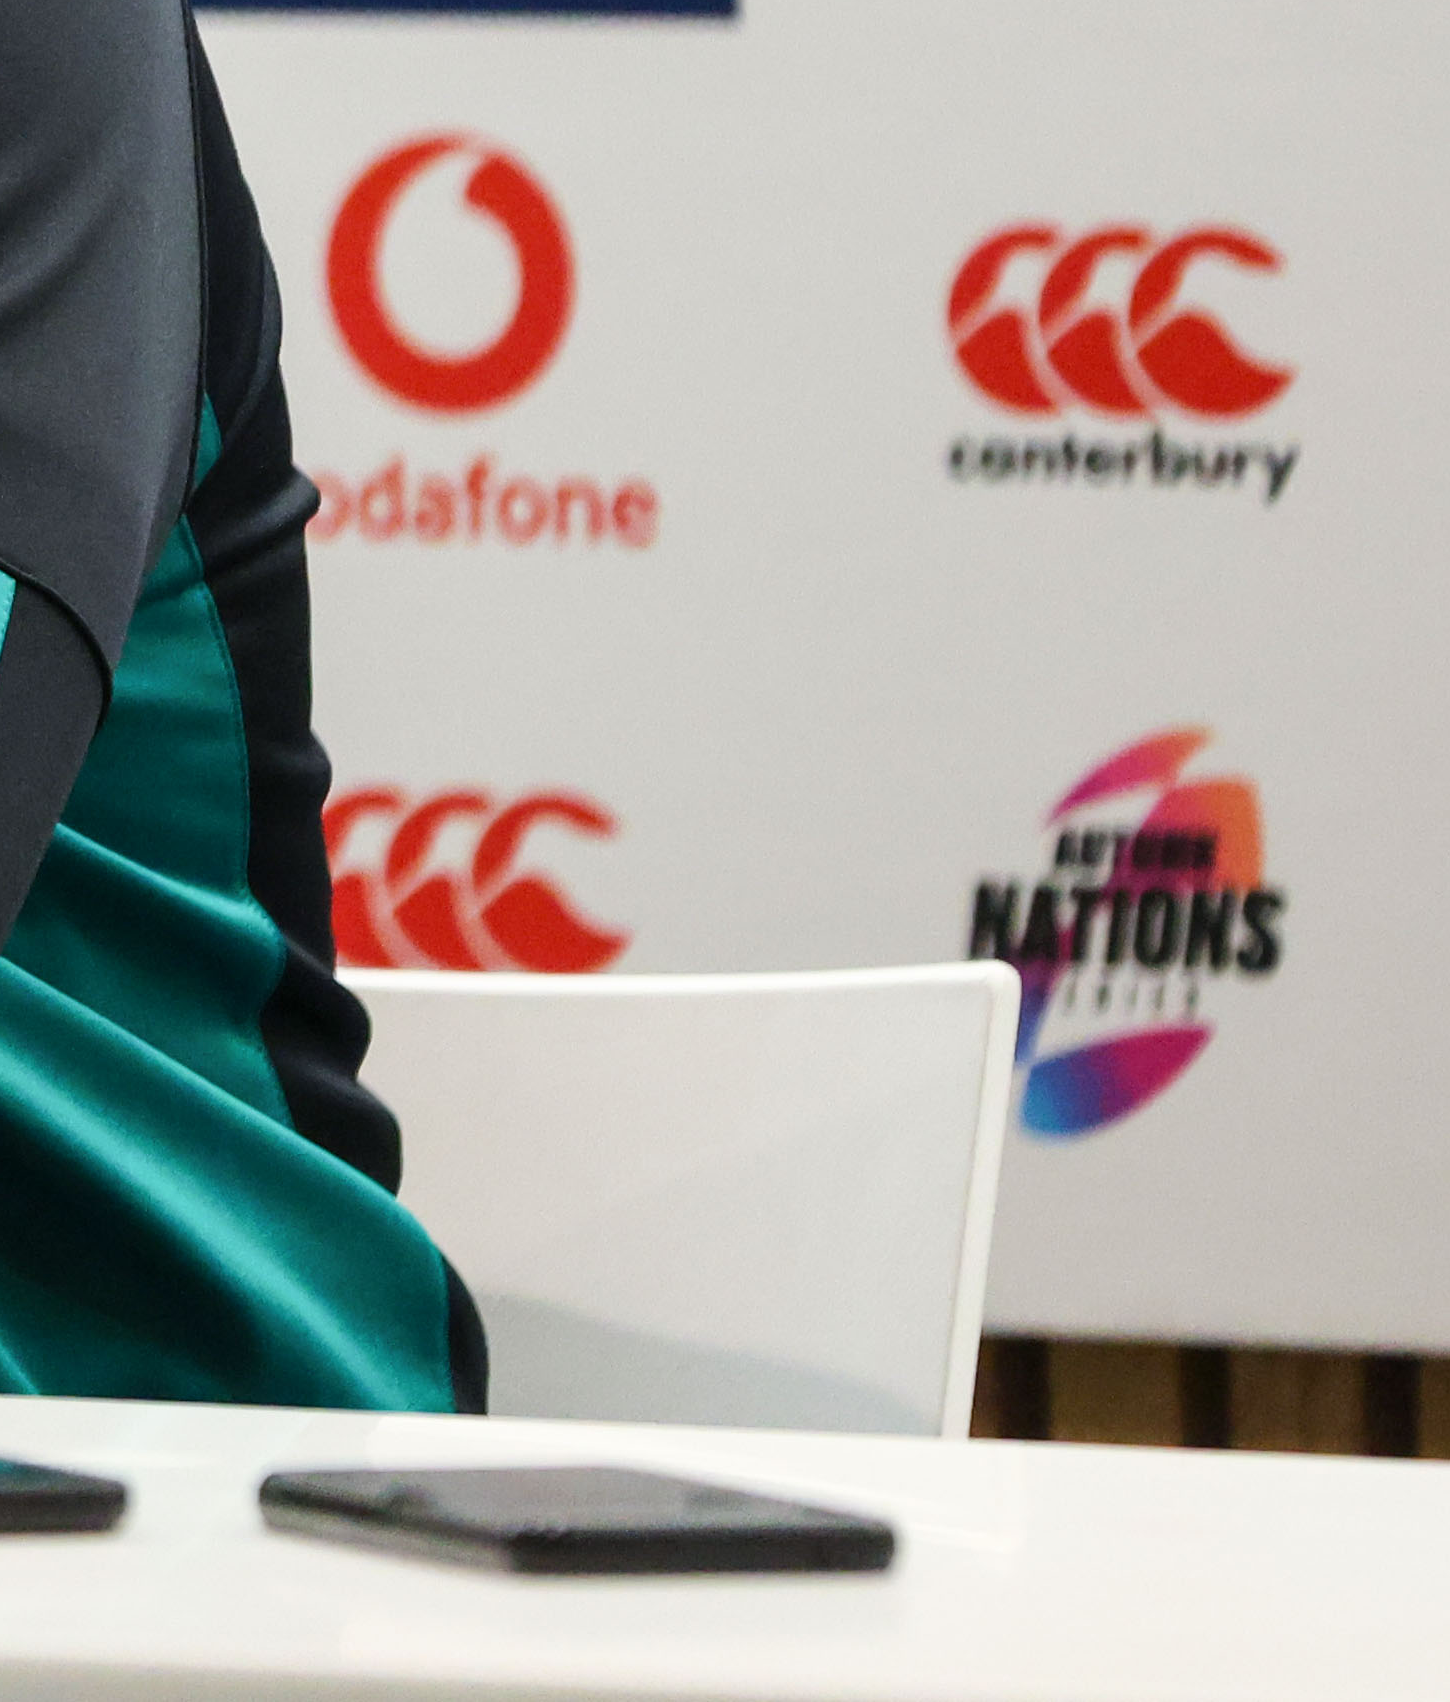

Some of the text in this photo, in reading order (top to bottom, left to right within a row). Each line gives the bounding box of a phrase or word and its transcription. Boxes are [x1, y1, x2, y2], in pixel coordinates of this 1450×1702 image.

[306, 452, 659, 550] odafone
[945, 426, 1301, 508] canterbury
[967, 880, 1287, 976] NATIONS
